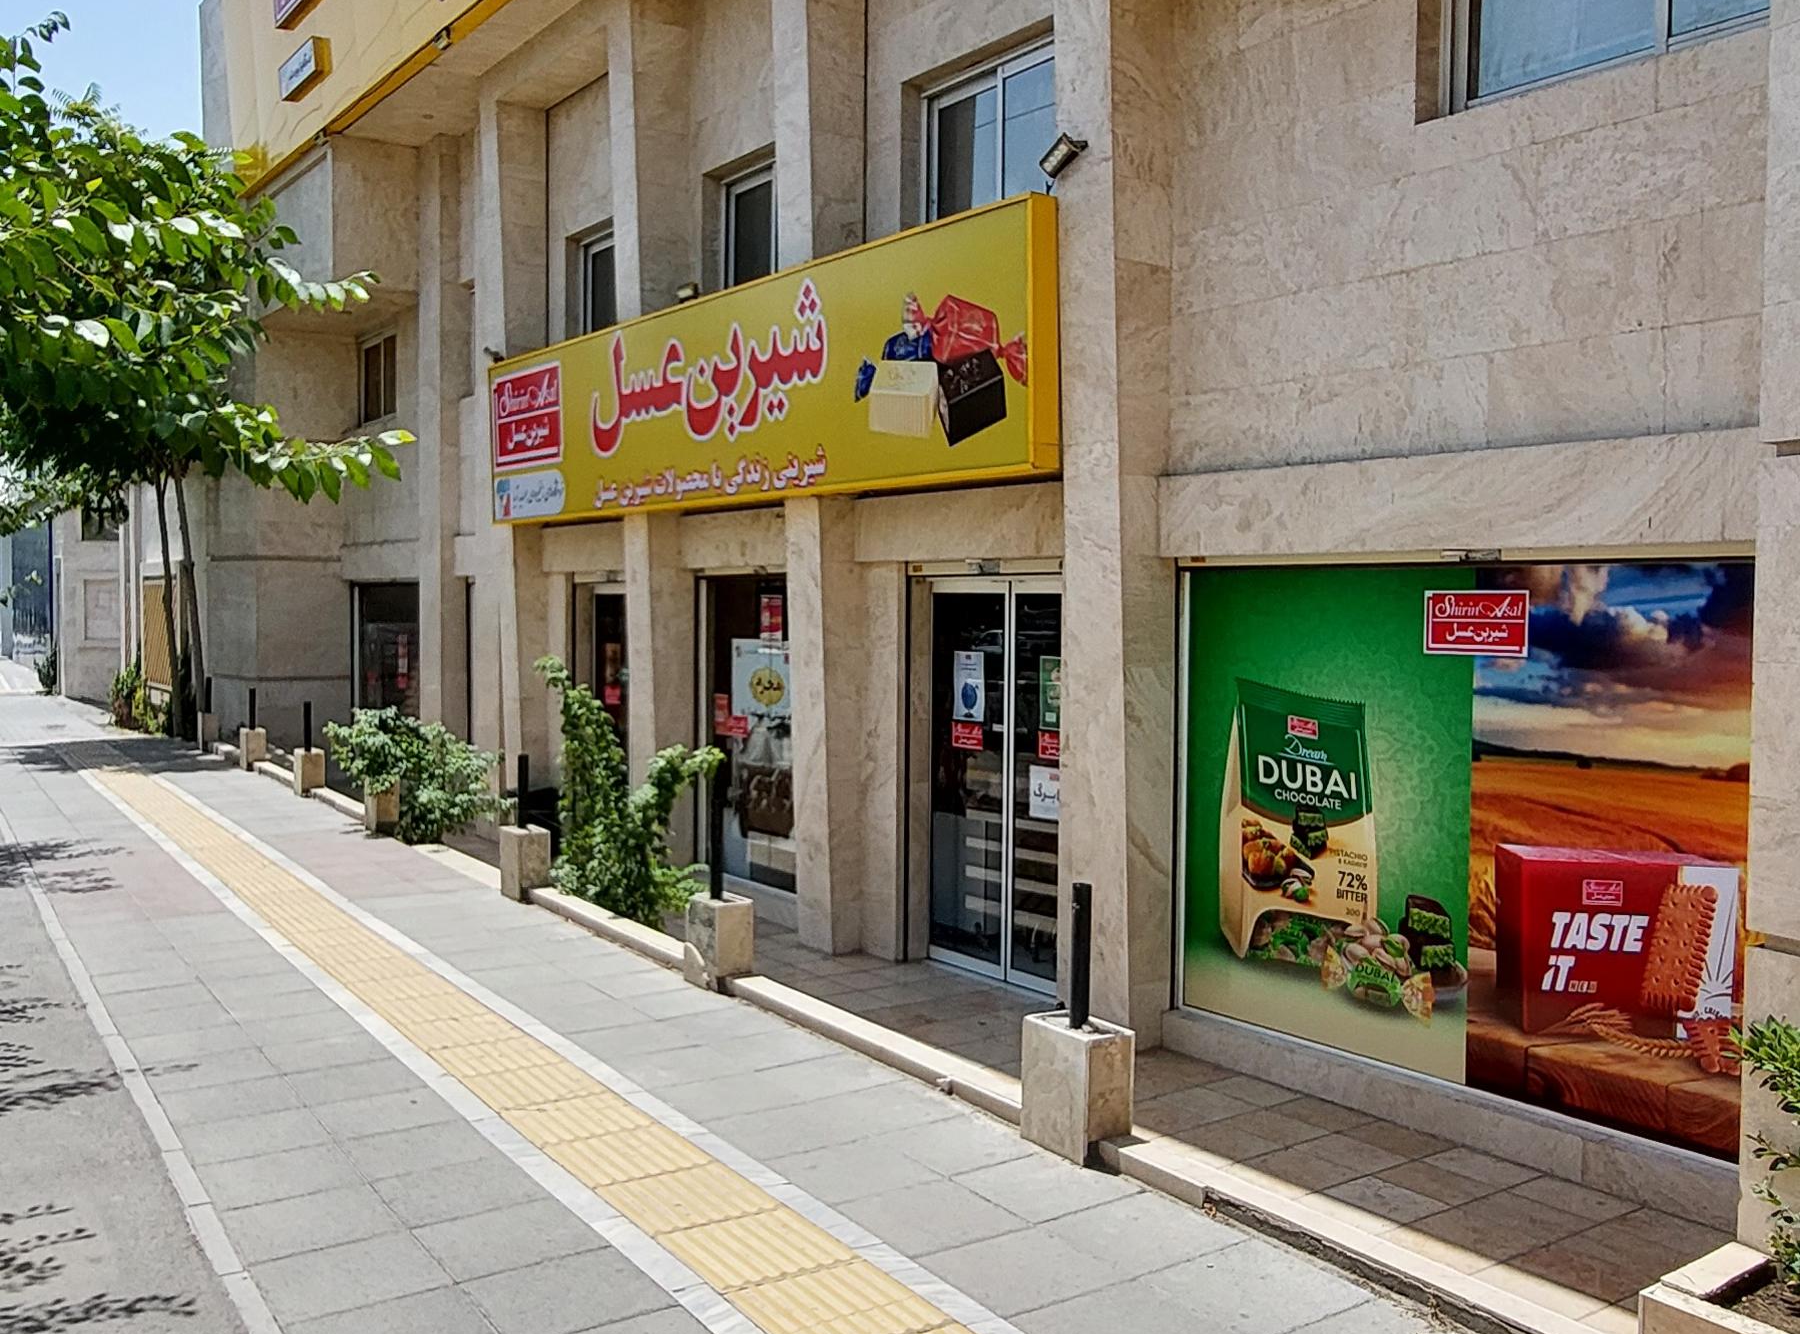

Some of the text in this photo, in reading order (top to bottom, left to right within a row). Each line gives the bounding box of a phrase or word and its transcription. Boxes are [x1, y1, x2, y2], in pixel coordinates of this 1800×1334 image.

[590, 277, 828, 458] شیرین عسل
[653, 466, 709, 500] محصولات
[710, 459, 722, 493] با
[724, 452, 770, 495] زندگی
[772, 443, 828, 490] شیرینی
[593, 475, 618, 509] عسل
[618, 474, 653, 506] شیرین
[1434, 594, 1523, 618] Shirin Asal
[1445, 622, 1509, 643] شیرین عسل
[1257, 754, 1358, 801] DUBAI
[1274, 788, 1343, 811] CHOCOLATE
[1328, 848, 1368, 862] PISTACHIO
[1336, 888, 1368, 904] BITTER
[1337, 870, 1368, 891] 72%
[1550, 911, 1650, 952] TASTE
[1354, 963, 1395, 984] DUBAI
